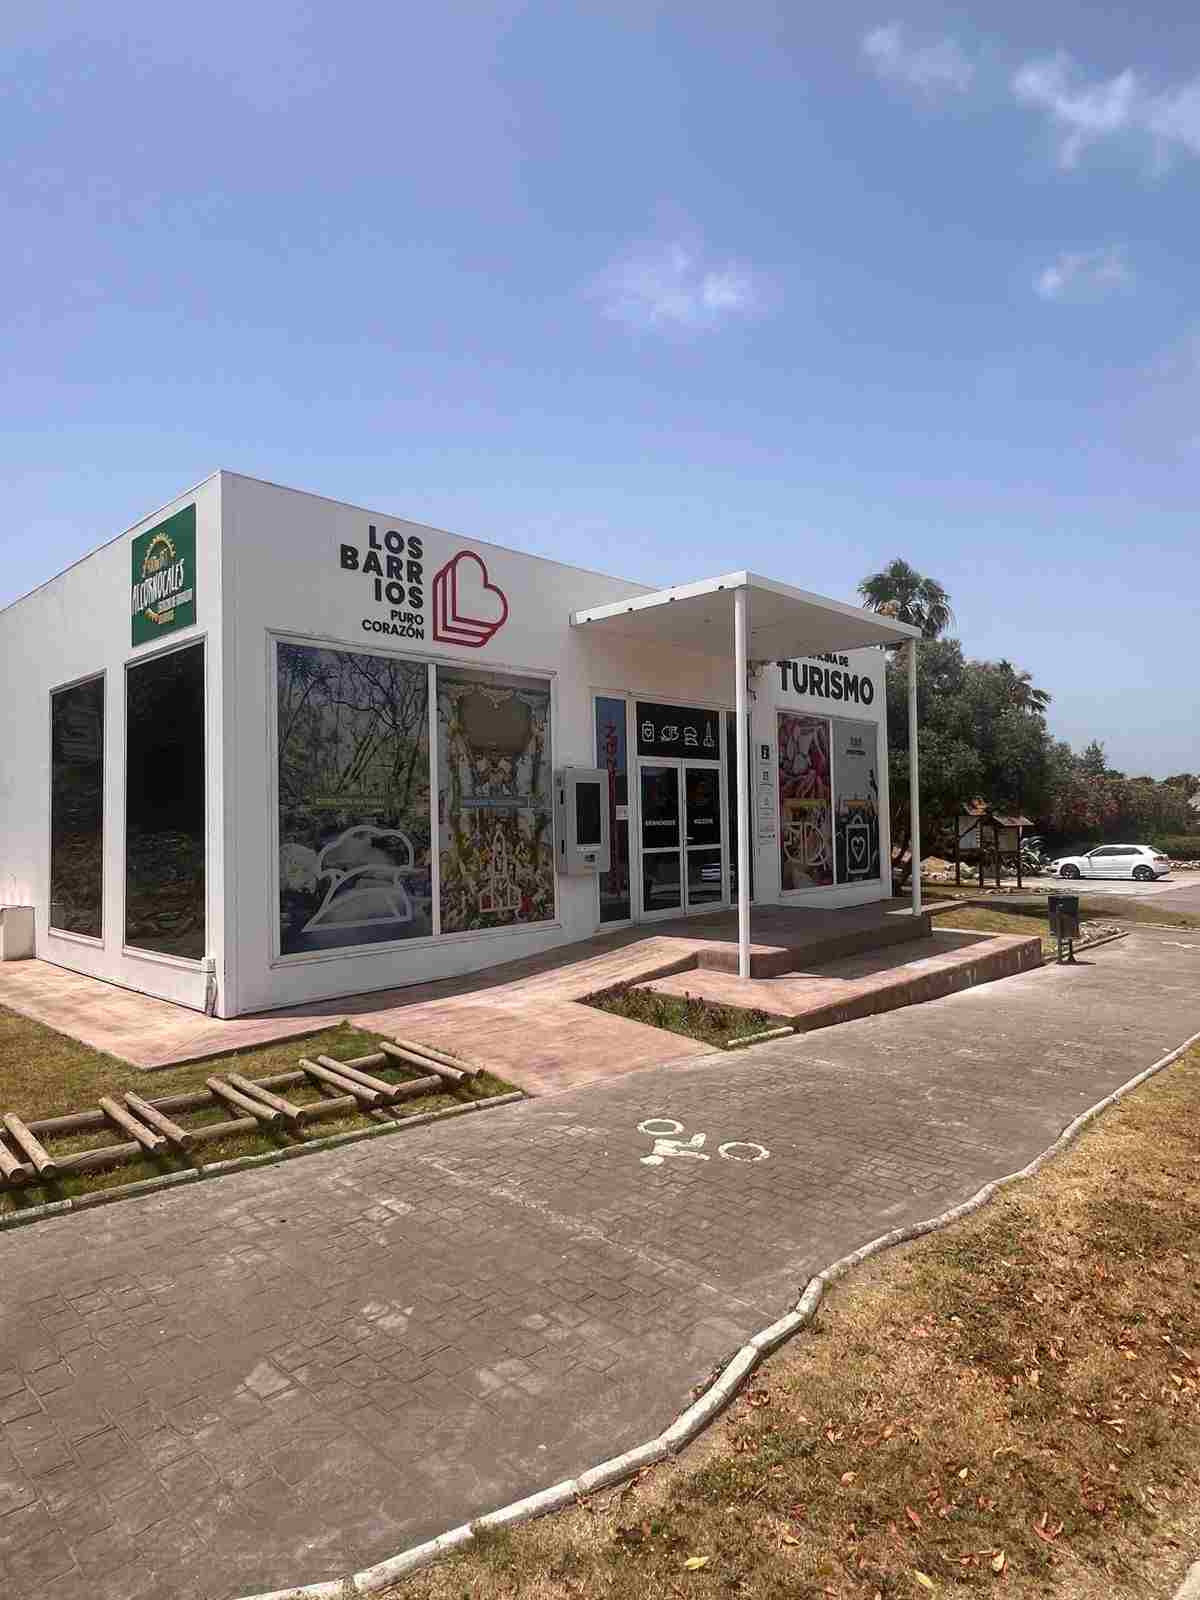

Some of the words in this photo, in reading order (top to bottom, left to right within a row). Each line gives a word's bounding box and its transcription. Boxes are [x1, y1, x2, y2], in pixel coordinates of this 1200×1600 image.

[368, 525, 423, 559] LOS
[340, 543, 423, 584] BARR
[374, 578, 424, 609] IOS
[362, 619, 424, 640] CORAZÓN
[390, 610, 424, 625] PURO
[776, 661, 874, 705] TURISMO
